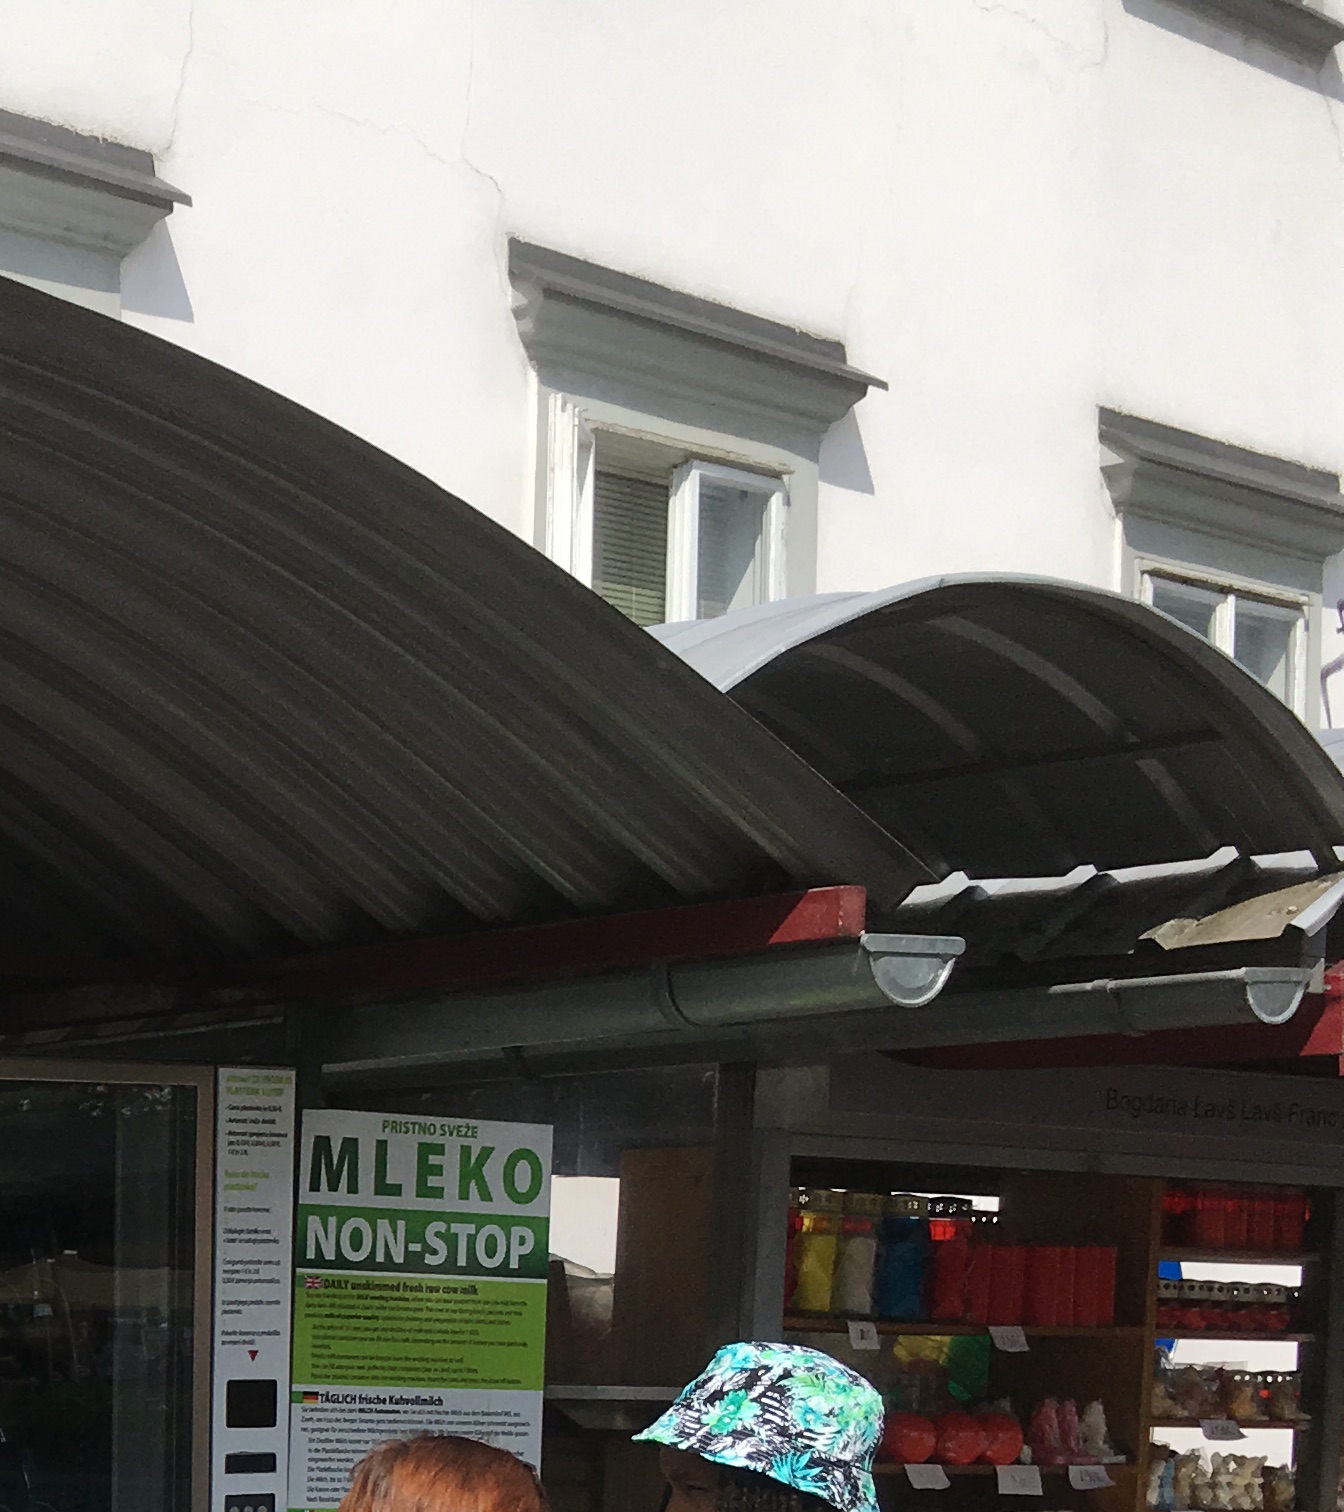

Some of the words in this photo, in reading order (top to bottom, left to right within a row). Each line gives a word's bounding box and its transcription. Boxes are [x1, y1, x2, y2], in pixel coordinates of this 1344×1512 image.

[381, 1119, 437, 1137] PRISTNO
[439, 1120, 479, 1139] SVEŽE
[308, 1134, 544, 1205] MLEKO
[305, 1214, 536, 1269] NON-STOP
[324, 1279, 349, 1289] DAILY
[319, 1391, 357, 1404] TÄGLICH
[358, 1393, 387, 1405] frische
[388, 1394, 443, 1406] Kuhvollmilch
